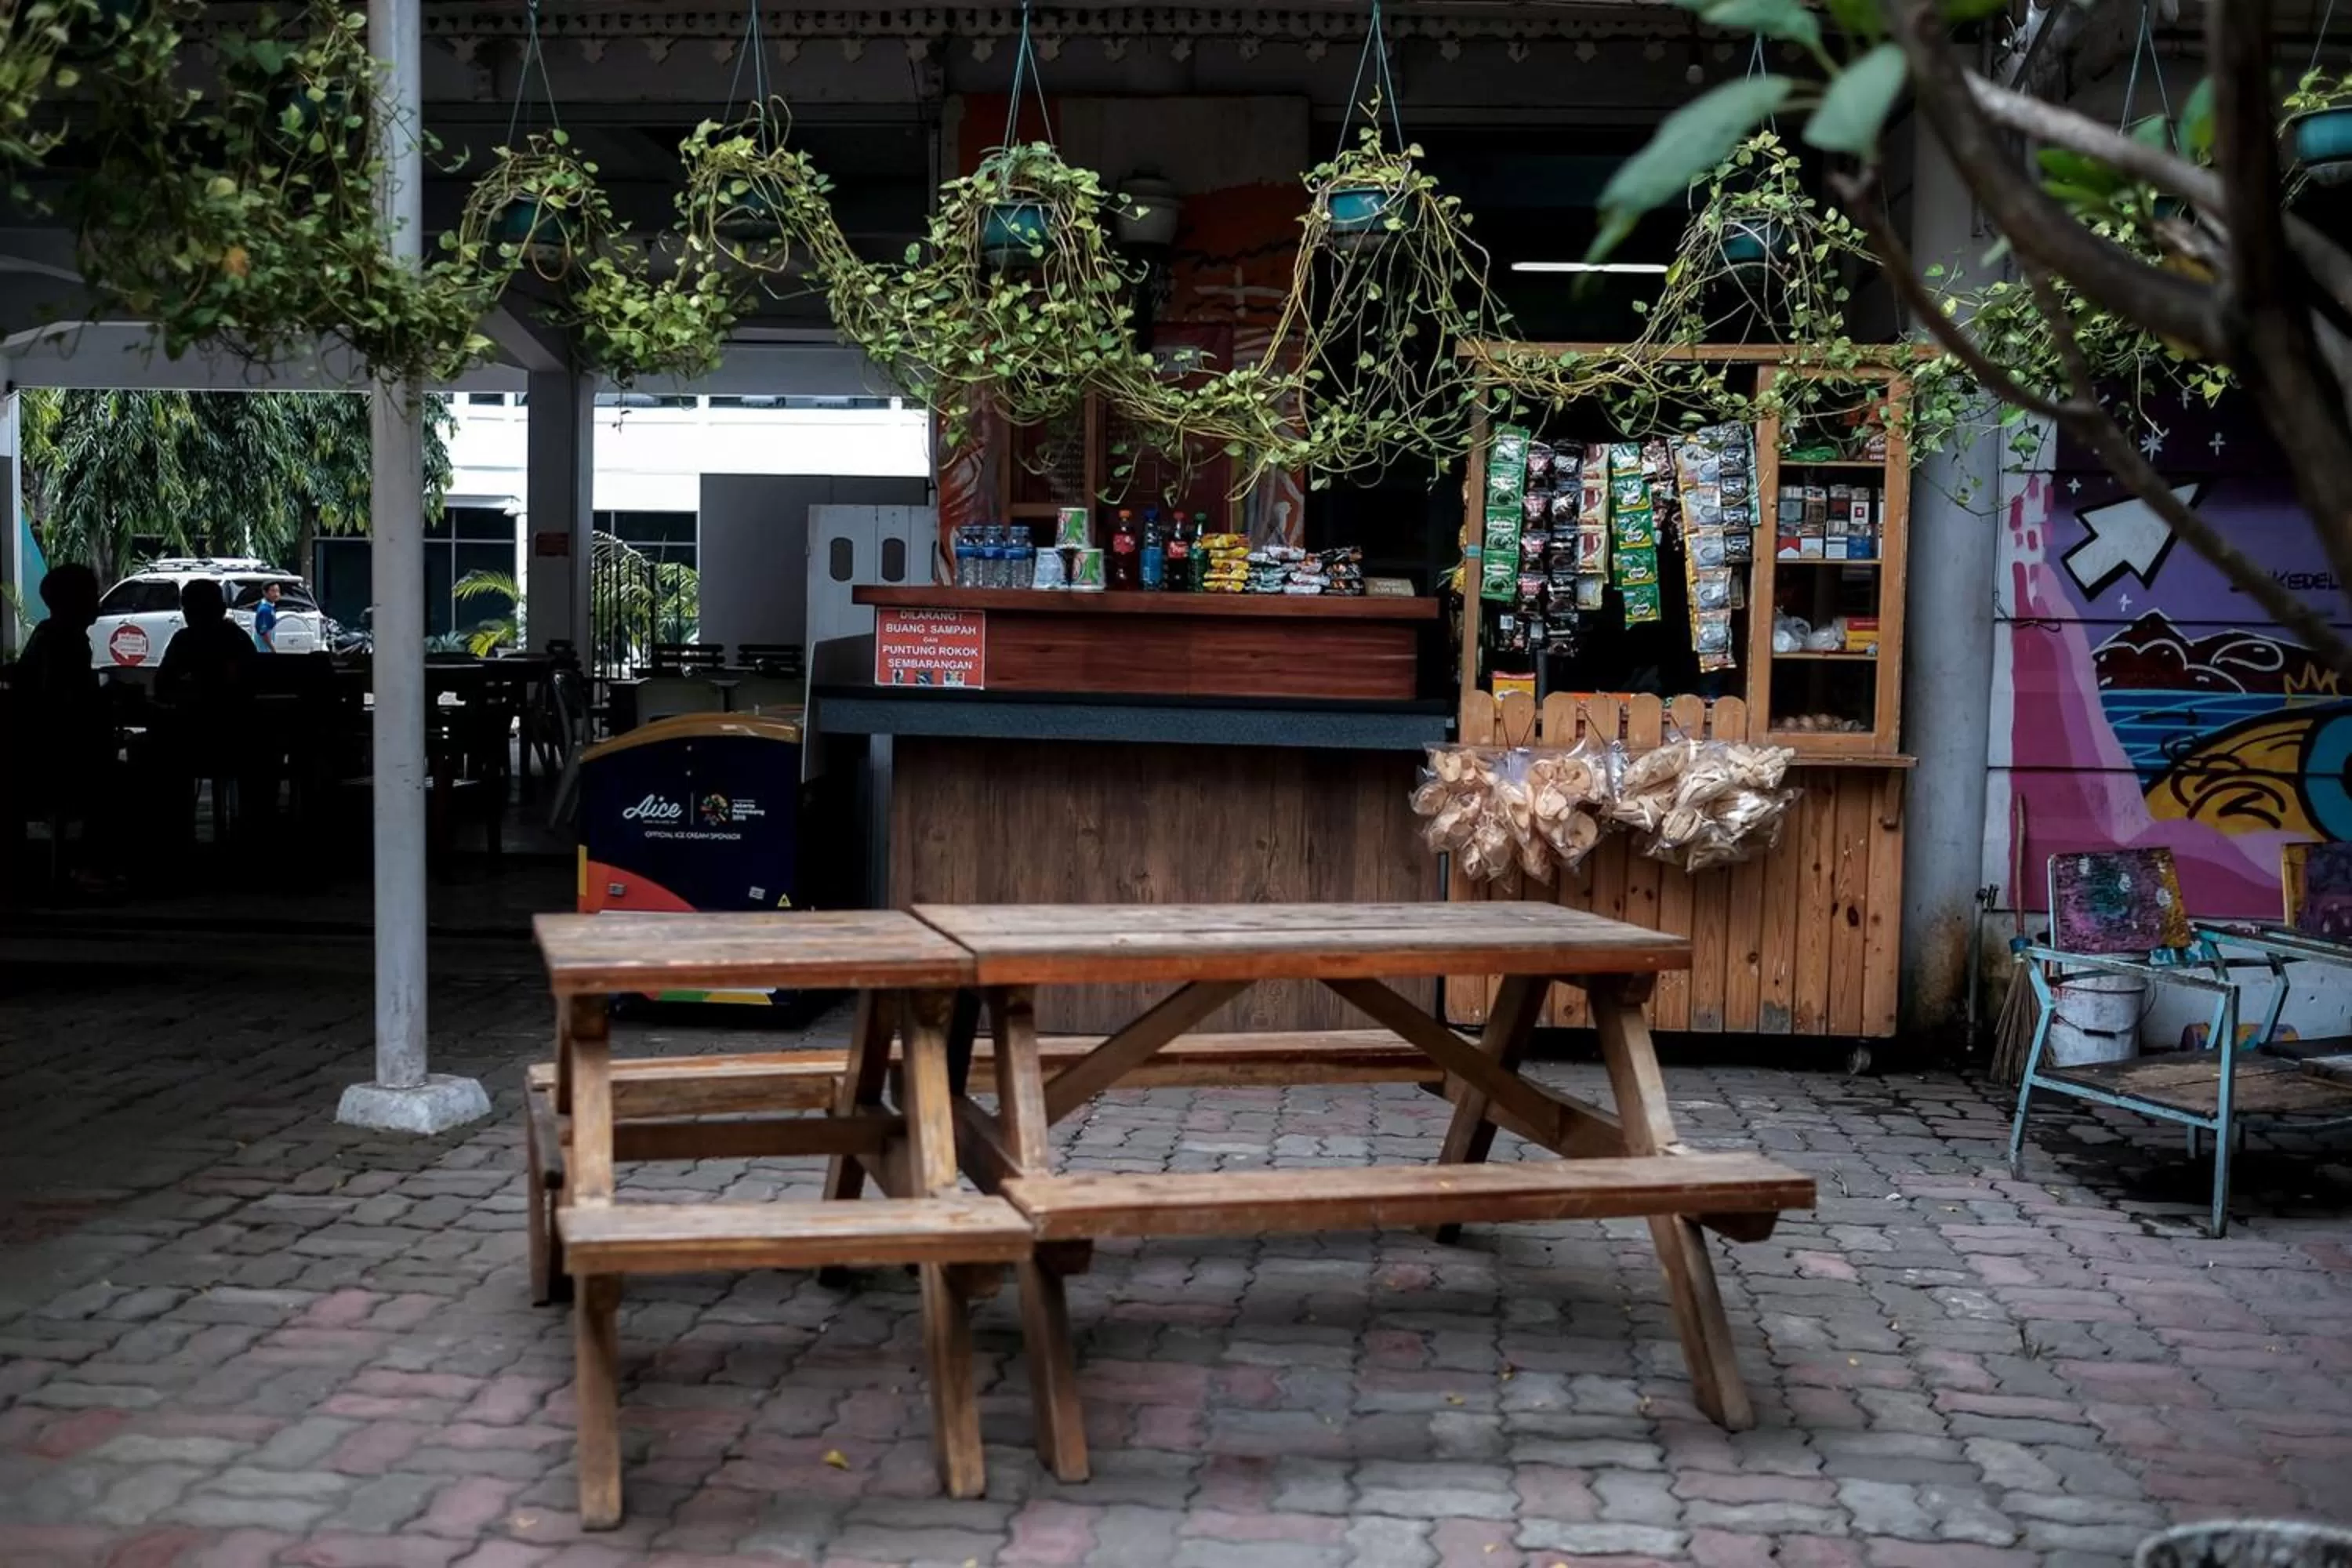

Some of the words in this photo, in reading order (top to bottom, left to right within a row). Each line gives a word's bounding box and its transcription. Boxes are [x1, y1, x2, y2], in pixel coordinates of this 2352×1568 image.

[885, 623, 925, 633] BUANG
[931, 625, 976, 635] SAMPAH
[883, 644, 936, 655] PUNTUNG
[939, 646, 978, 656] ROKOK
[887, 658, 972, 670] SEMBARANGAN
[622, 793, 683, 819] Aice
